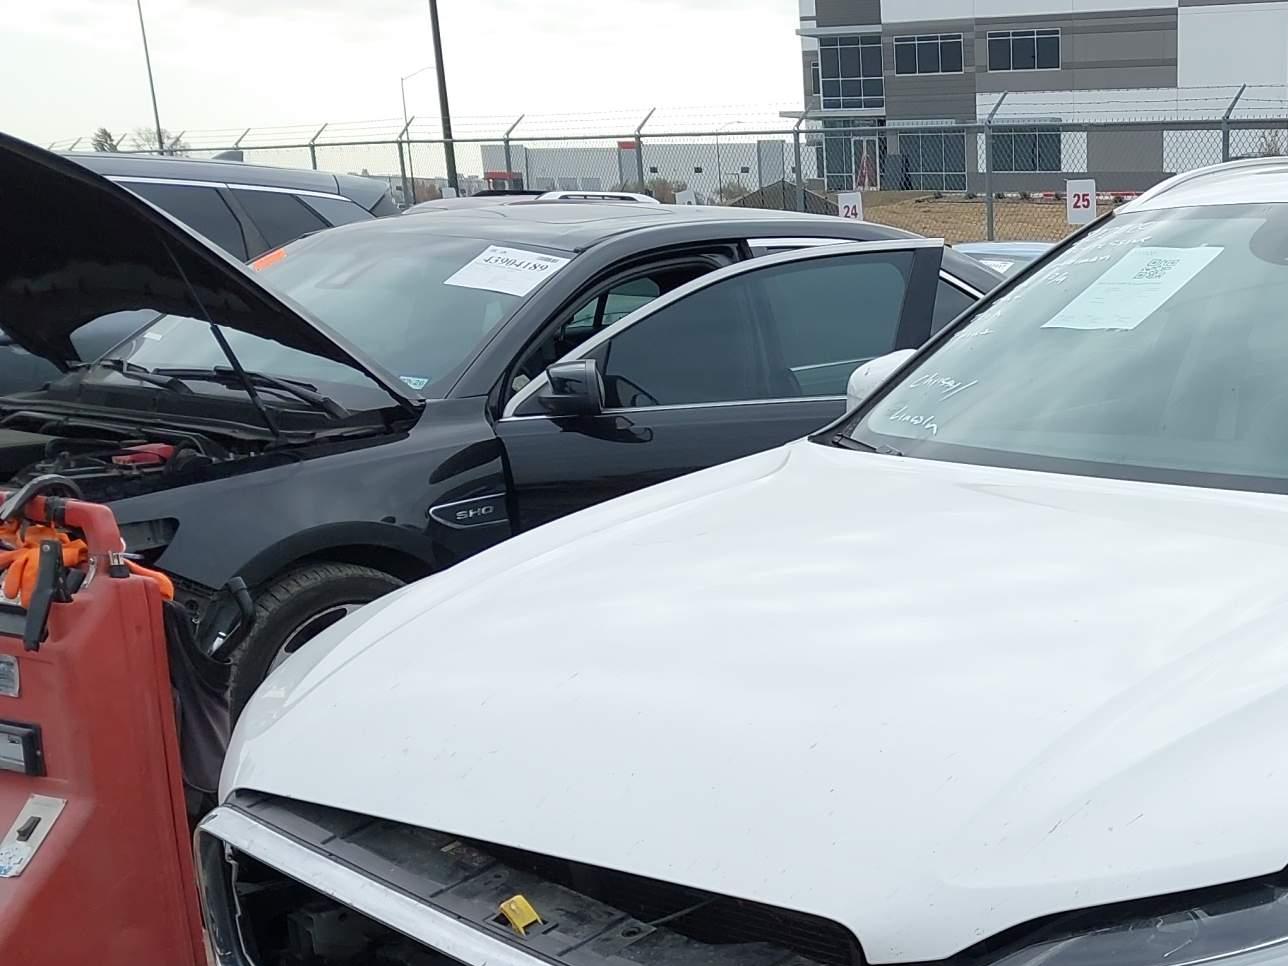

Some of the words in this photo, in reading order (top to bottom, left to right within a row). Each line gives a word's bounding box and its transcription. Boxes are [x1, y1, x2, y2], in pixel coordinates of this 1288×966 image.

[1073, 193, 1090, 208] 25
[843, 205, 858, 218] 24
[483, 255, 549, 271] 43904189
[455, 505, 494, 520] SHO
